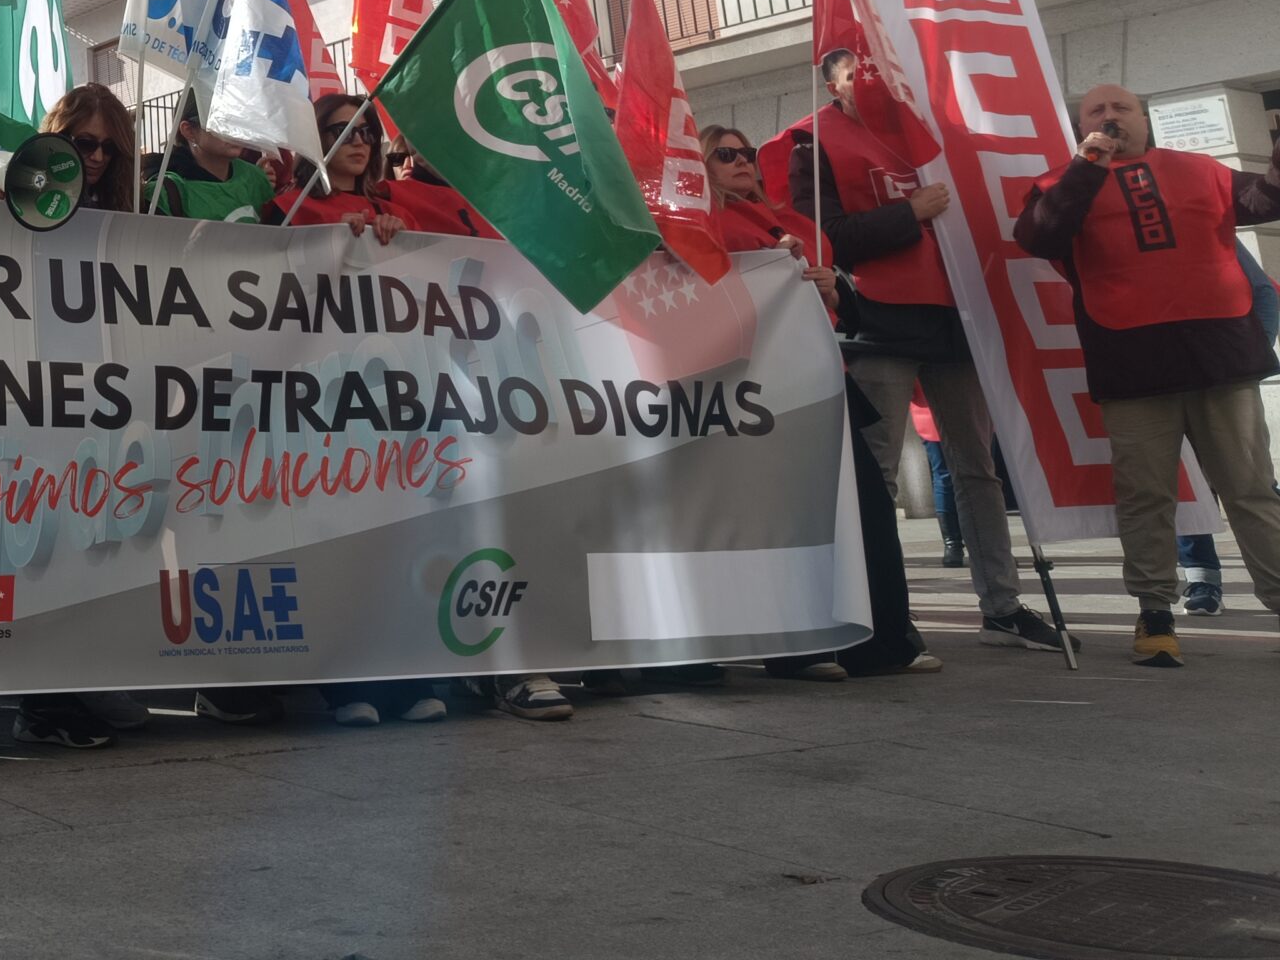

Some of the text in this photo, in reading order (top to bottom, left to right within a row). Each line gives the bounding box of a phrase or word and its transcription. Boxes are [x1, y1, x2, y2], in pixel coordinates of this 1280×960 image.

[48, 257, 211, 328] UNA
[227, 269, 501, 341] SANIDAD
[154, 365, 234, 432] DE
[251, 368, 550, 437] TRABAJO
[560, 378, 775, 437] DIGNAS
[176, 427, 473, 515] soluciones
[455, 579, 528, 618] CSIF
[183, 647, 217, 657] SINDICAL
[217, 647, 223, 655] Y
[224, 645, 262, 655] TÉCNICOS
[262, 644, 310, 654] SANITARIOS
